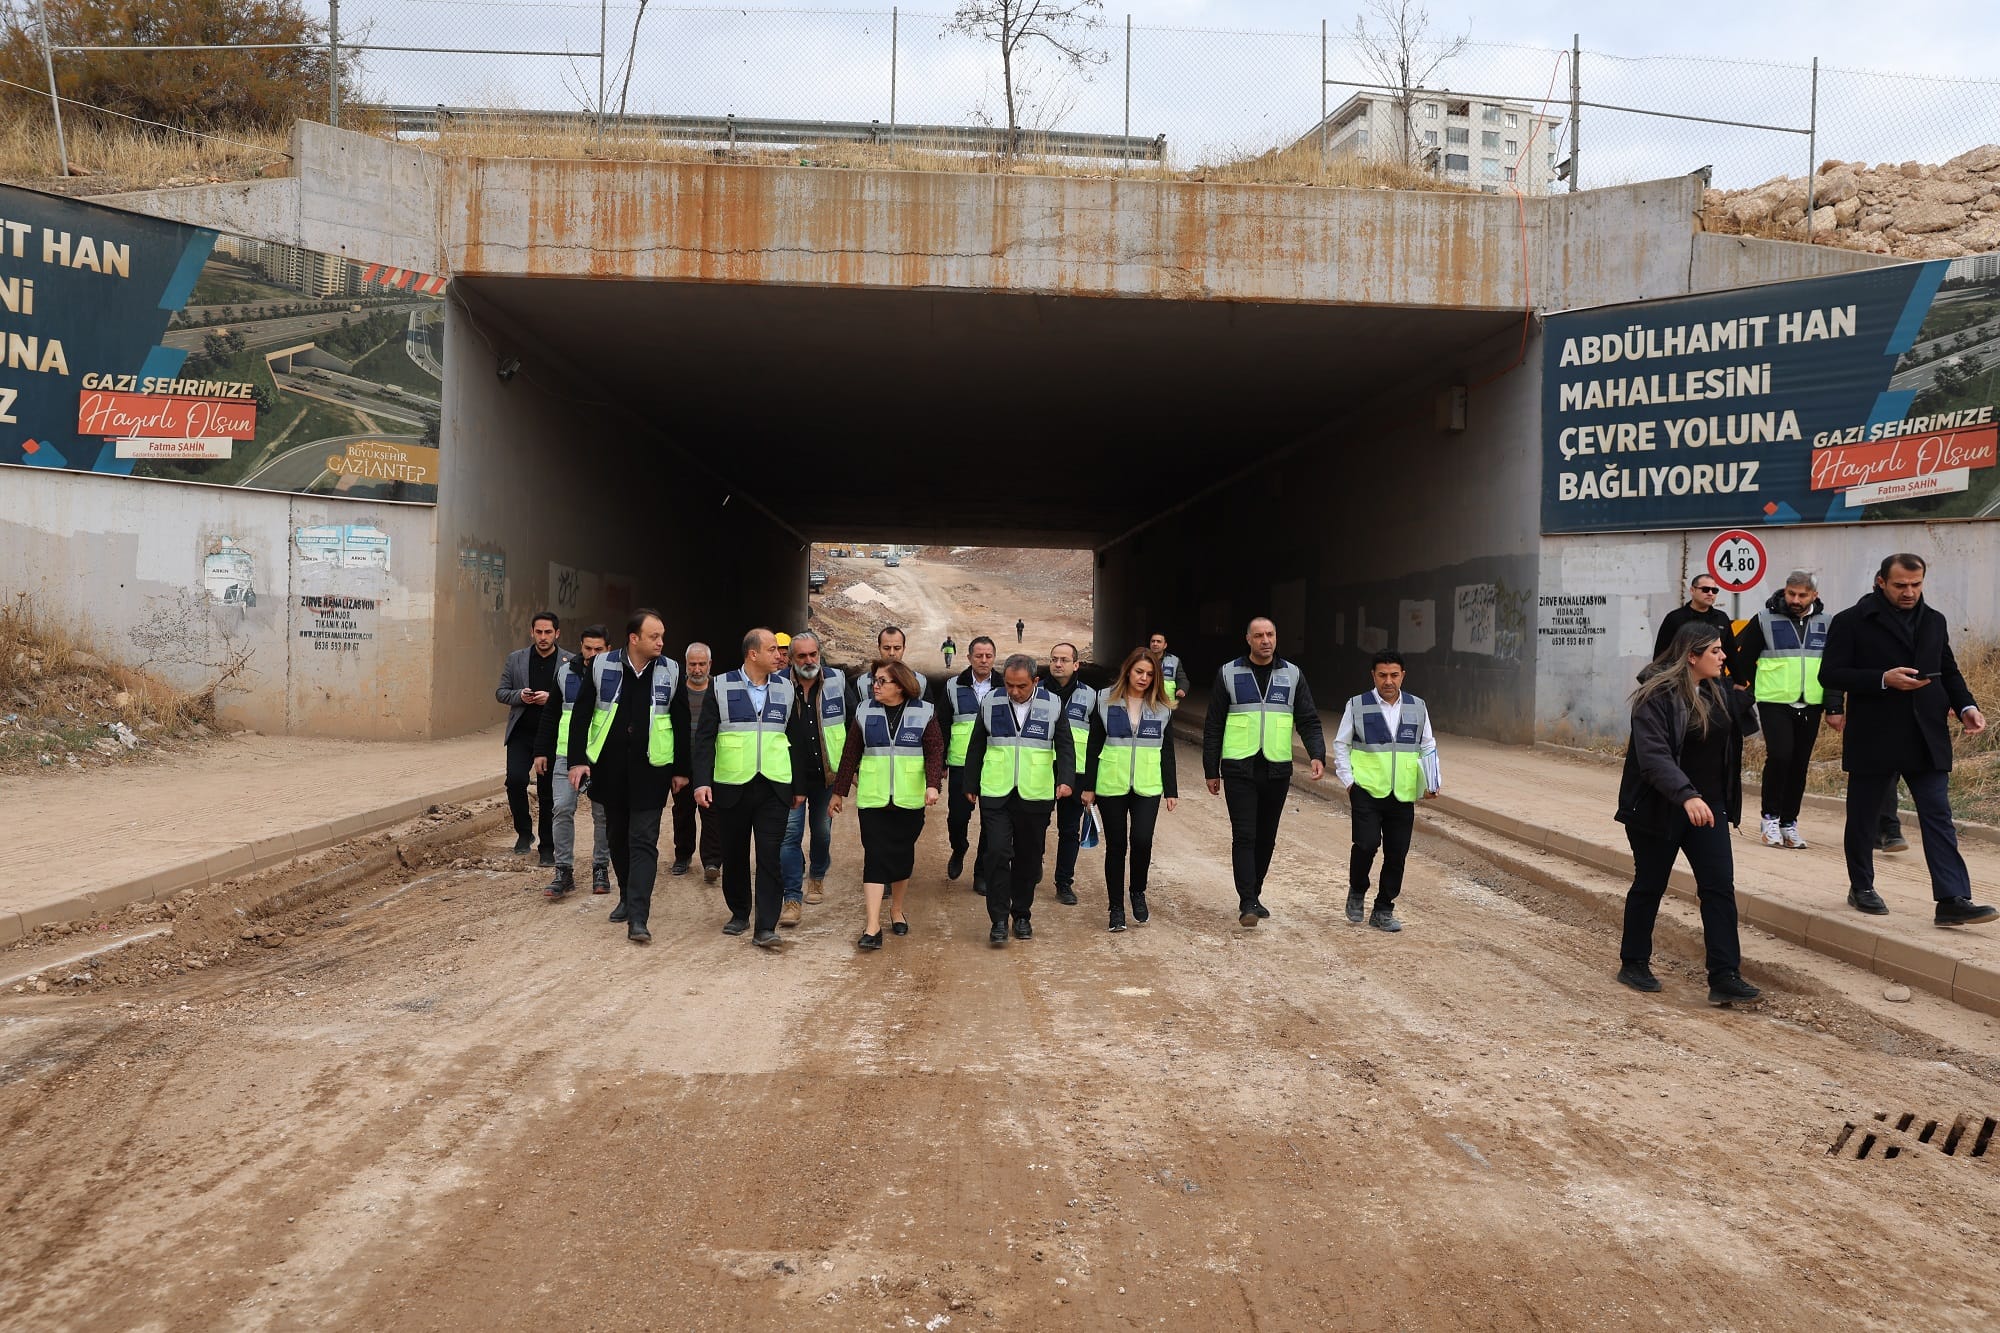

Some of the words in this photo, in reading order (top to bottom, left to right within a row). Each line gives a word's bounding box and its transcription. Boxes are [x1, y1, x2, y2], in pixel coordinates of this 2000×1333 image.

[43, 228, 130, 278] HAN
[0, 331, 69, 376] NA
[1560, 314, 1769, 368] ABDÜLHAMİT
[1778, 305, 1856, 345] HAN
[82, 372, 138, 391] GAZİ
[141, 377, 254, 399] ŞEHRİMİZE
[1559, 363, 1772, 412] MAHALLESİNİ
[79, 393, 176, 440] Hayırlı
[185, 401, 253, 440] Olsun
[1559, 420, 1656, 461] ÇEVRE
[1663, 409, 1802, 450] YOLUNA
[1813, 425, 1865, 448] GAZİ
[1869, 405, 1994, 442] ŞEHRİMİZE
[149, 442, 176, 451] Fatma
[178, 441, 205, 452] ŞAHİN
[1811, 441, 1907, 488] Hayırlı
[1916, 433, 1993, 477] Olsun
[328, 457, 426, 482] GAZİANTEP
[1559, 461, 1760, 501] BAĞLIYORUZ
[1878, 485, 1905, 495] Fatma
[1908, 478, 1938, 491] ŞAHİN
